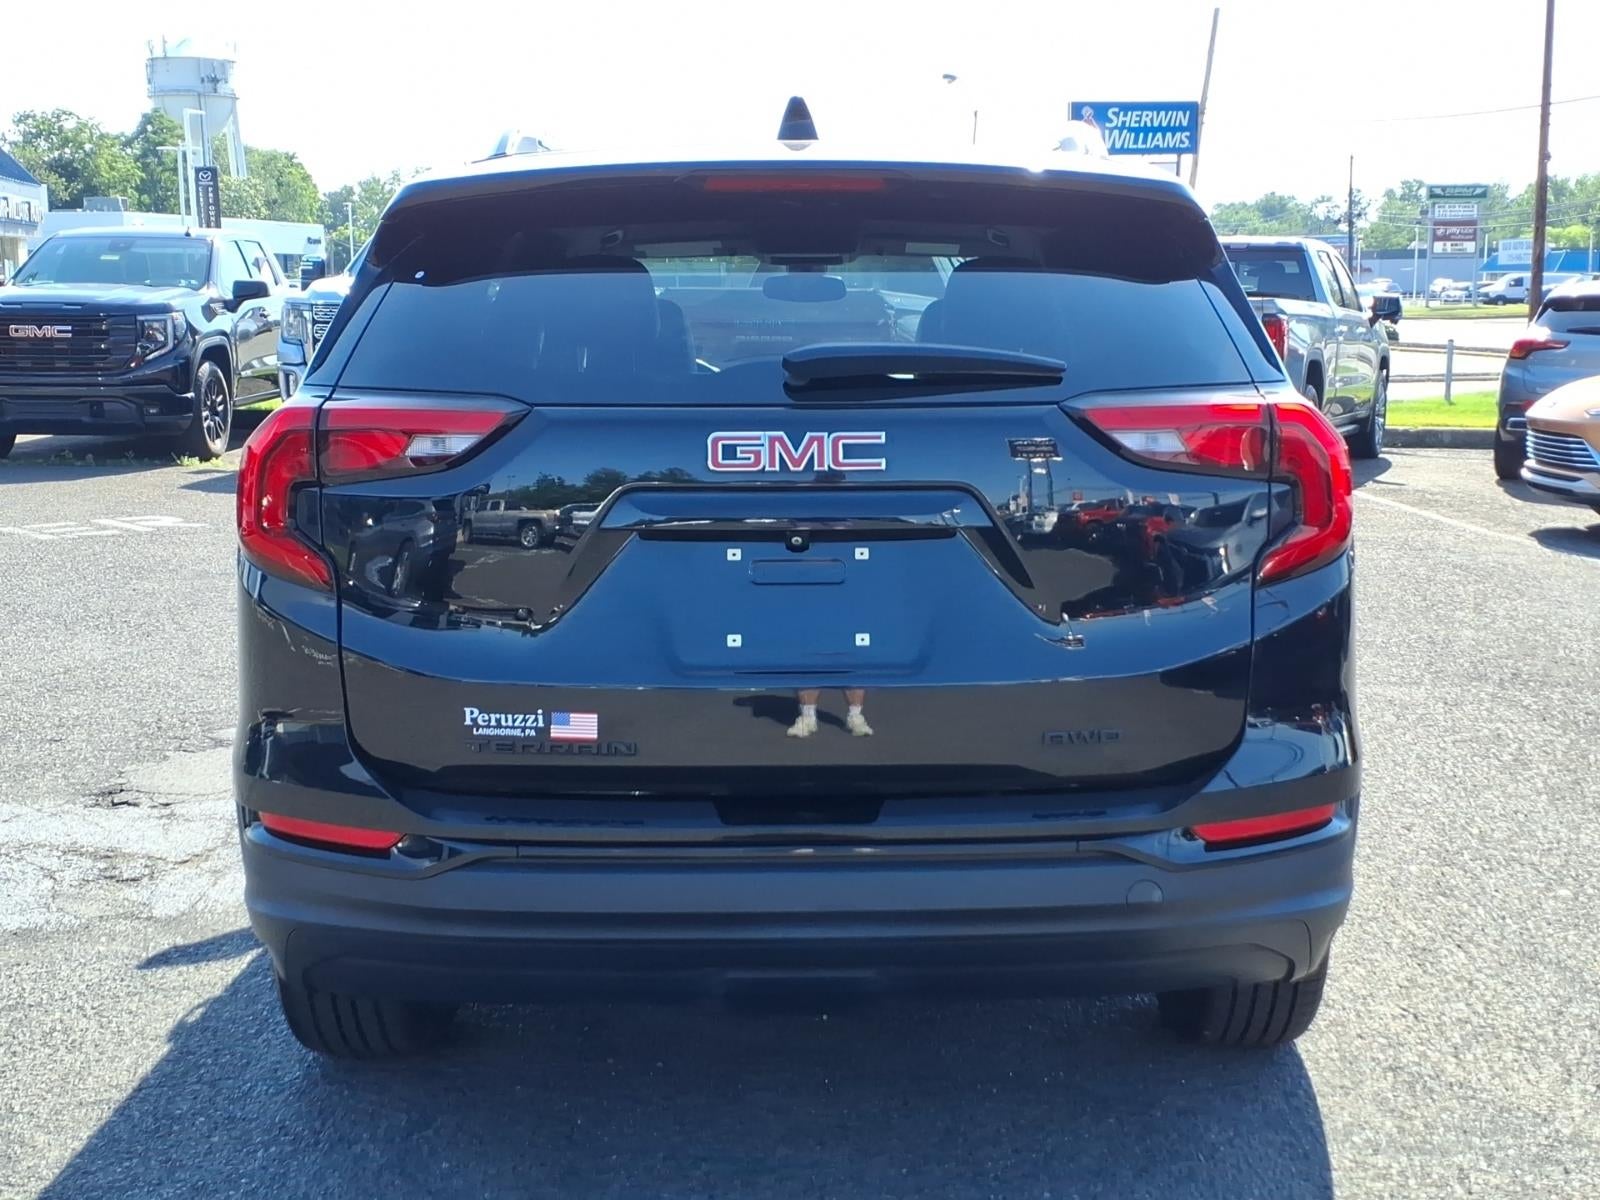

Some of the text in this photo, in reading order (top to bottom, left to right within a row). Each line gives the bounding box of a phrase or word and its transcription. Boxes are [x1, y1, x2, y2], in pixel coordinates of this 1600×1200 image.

[1105, 107, 1190, 127] SHERWIN
[1104, 129, 1190, 149] WILLIAMS
[9, 324, 73, 338] GMC
[707, 431, 886, 472] GMC
[464, 707, 545, 727] Peruzzi
[473, 727, 537, 738] LANGHORNE, PA
[467, 740, 638, 756] TERRAIN
